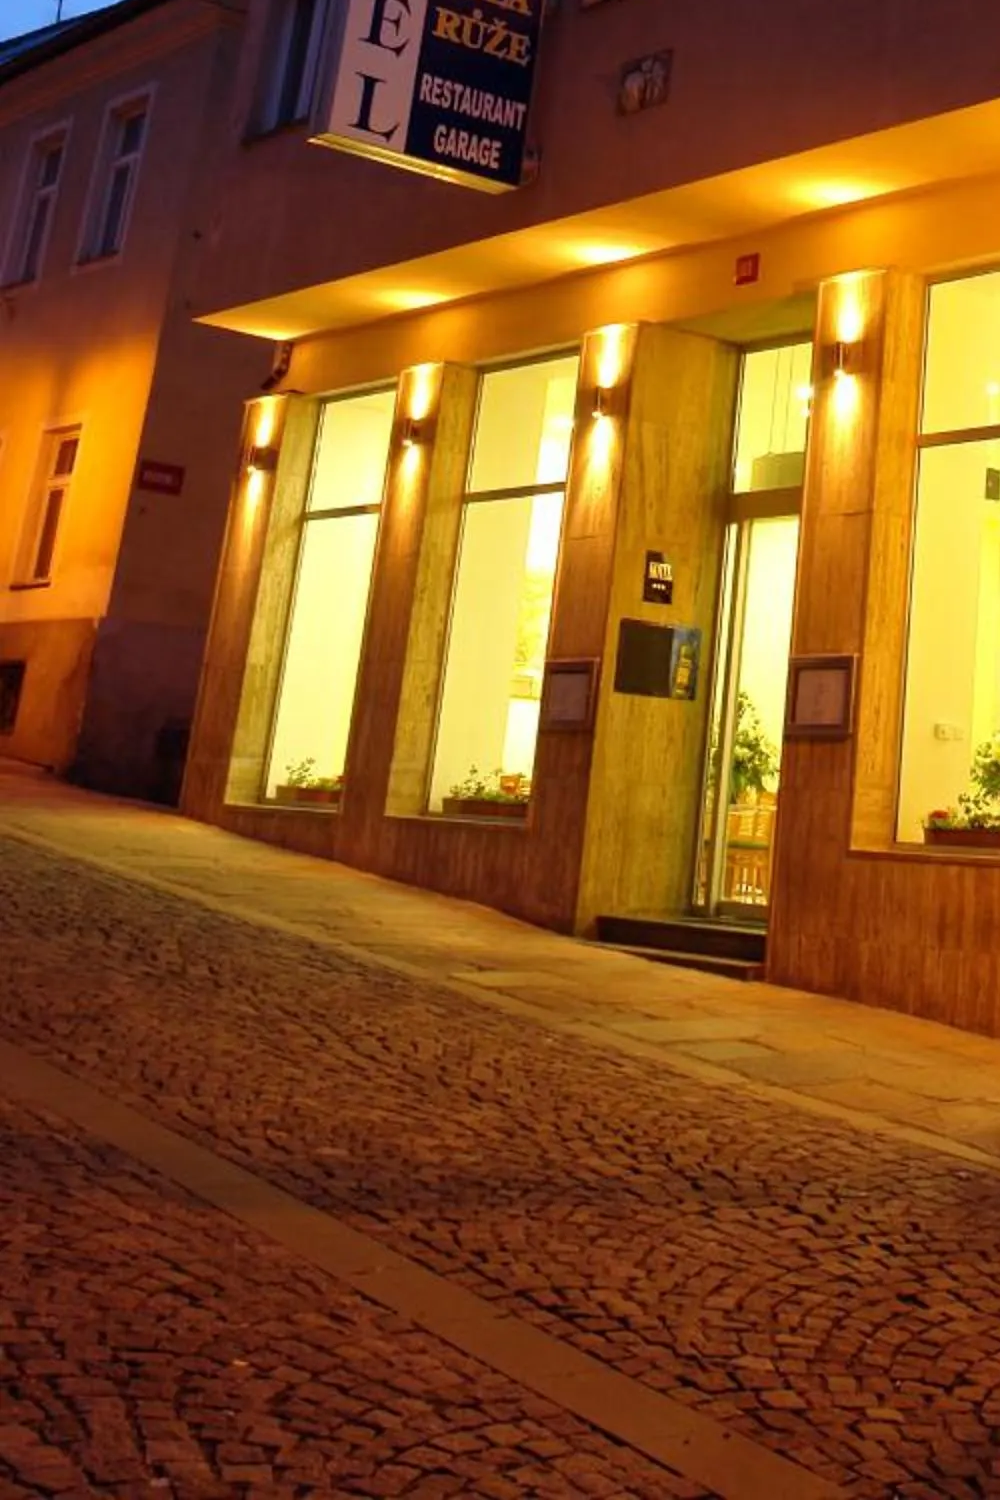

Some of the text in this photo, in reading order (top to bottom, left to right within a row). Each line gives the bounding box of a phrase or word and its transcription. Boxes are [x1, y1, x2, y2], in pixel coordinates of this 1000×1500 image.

[432, 6, 531, 67] RŮŽE
[420, 72, 527, 131] RESTAURANT
[433, 124, 502, 169] GARAGE
